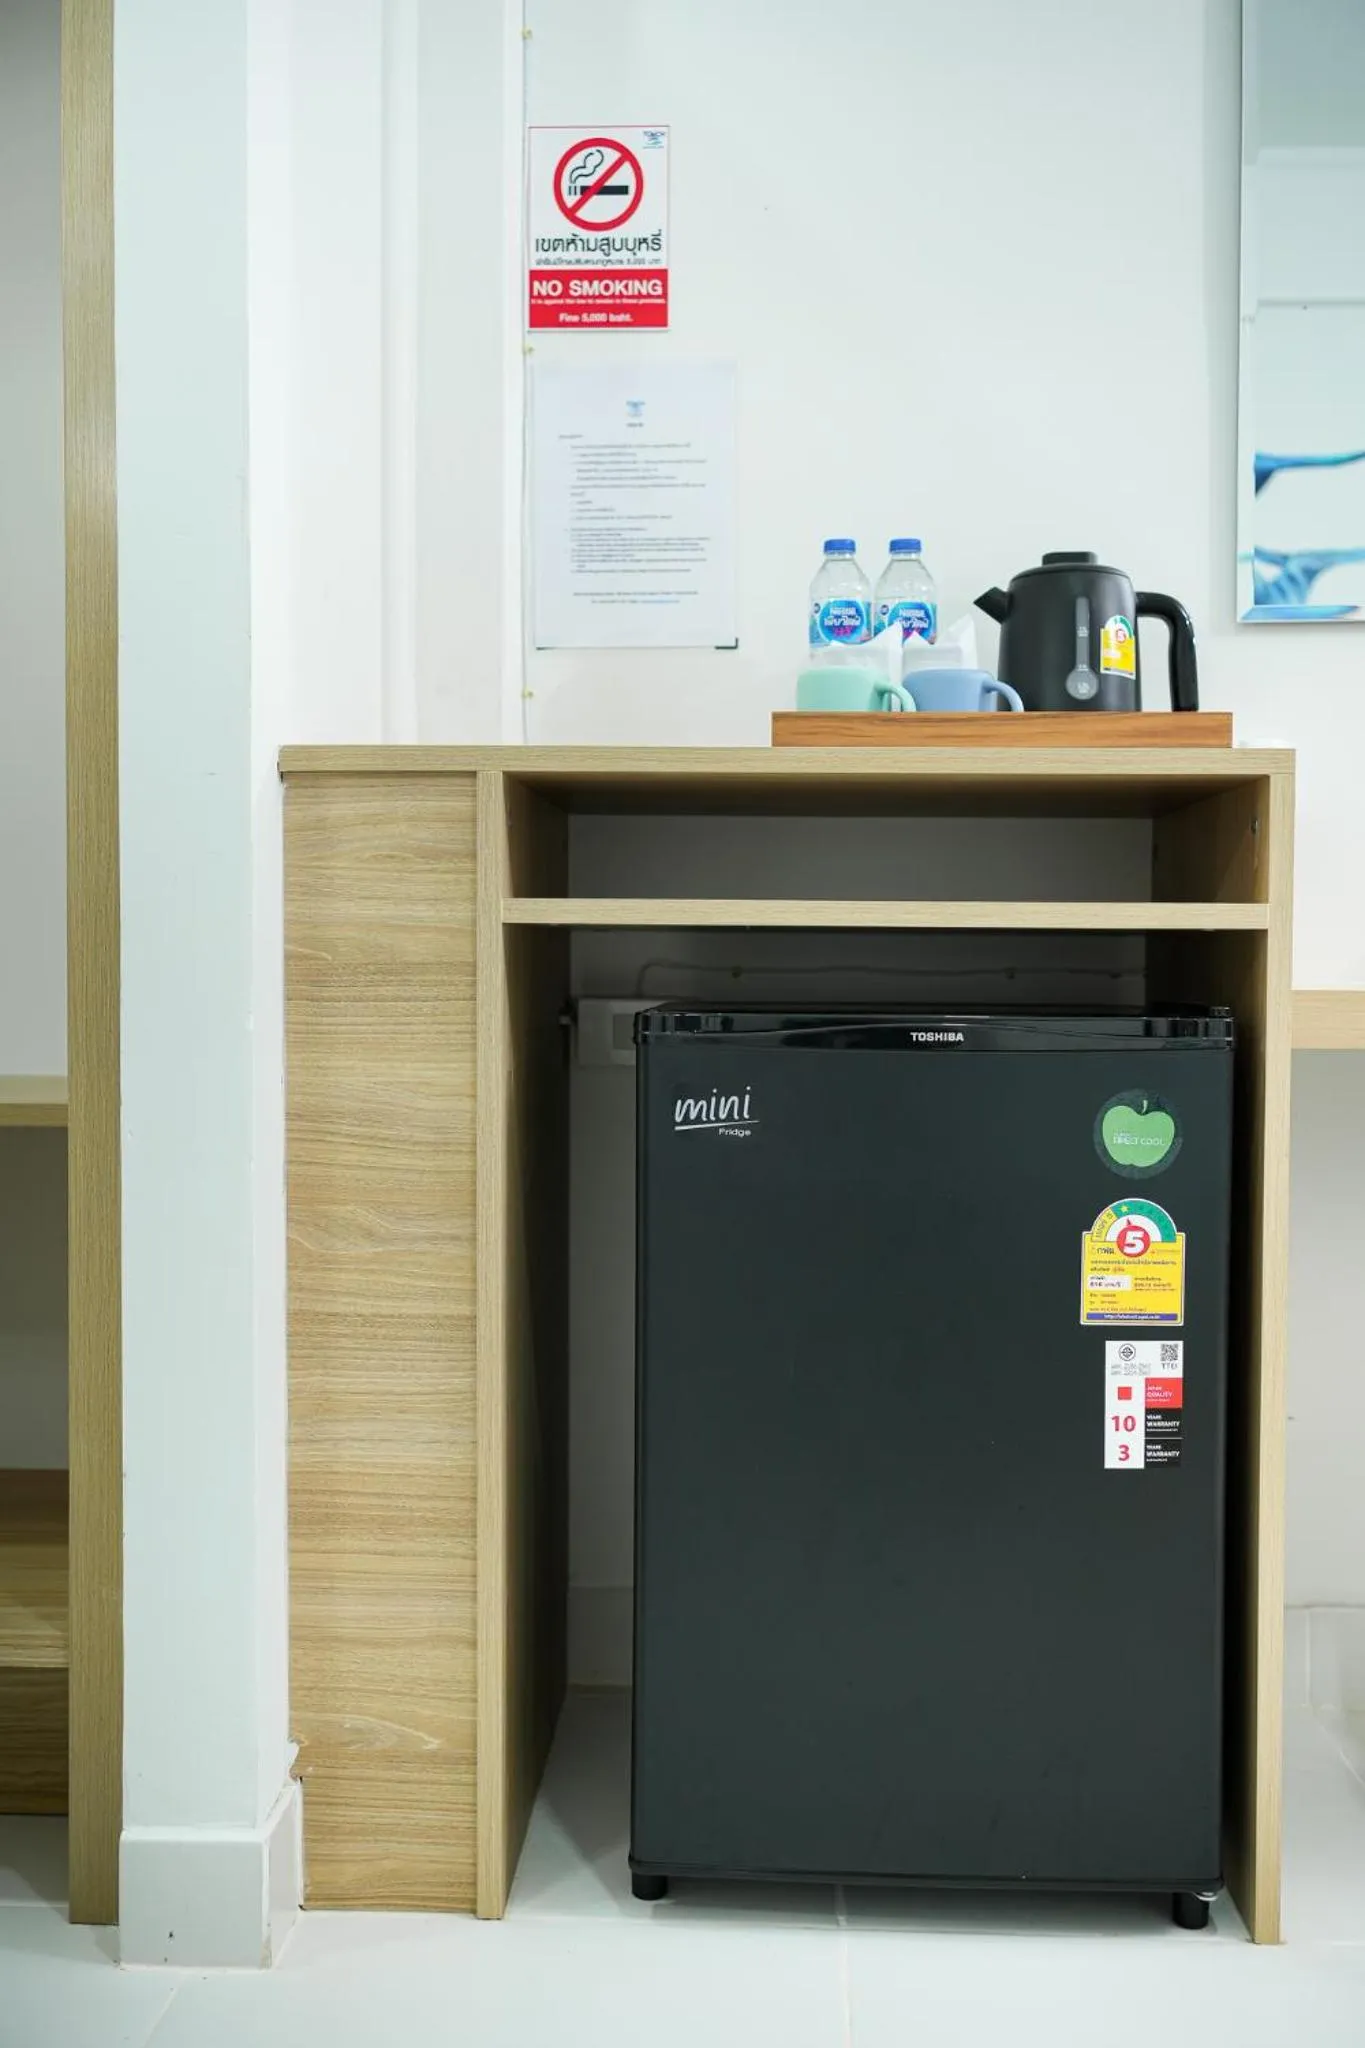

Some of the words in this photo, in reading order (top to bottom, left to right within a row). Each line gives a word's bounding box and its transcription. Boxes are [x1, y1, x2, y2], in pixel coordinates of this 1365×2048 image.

[535, 229, 662, 257] เขตห้ามสูบบุหรี่
[533, 280, 563, 297] NO
[569, 280, 663, 297] SMOKING
[558, 313, 580, 323] Fine
[910, 1031, 965, 1042] TOSHIBA
[674, 1085, 752, 1123] mini
[718, 1127, 752, 1138] Fridge
[1123, 1229, 1145, 1255] 5
[1111, 1415, 1137, 1432] 10
[1118, 1444, 1130, 1462] 3
